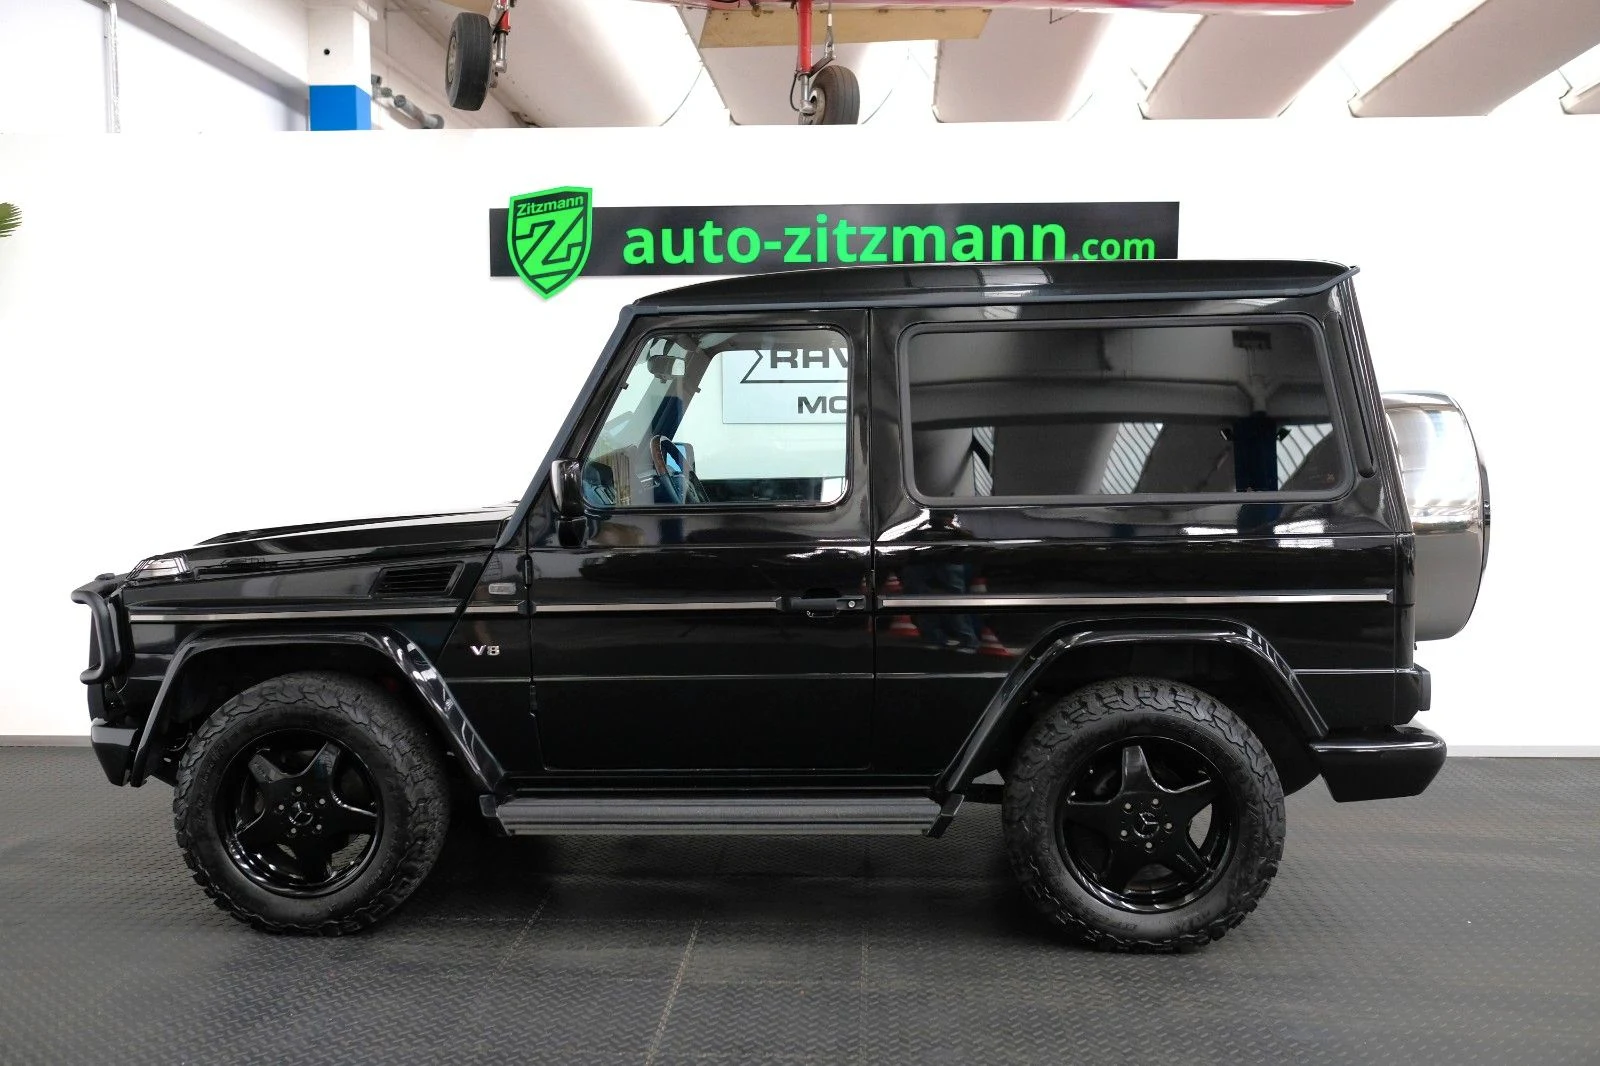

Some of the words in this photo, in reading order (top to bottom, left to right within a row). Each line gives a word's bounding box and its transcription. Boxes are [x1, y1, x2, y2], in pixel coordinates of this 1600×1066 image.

[516, 195, 585, 217] Zitzmann
[622, 213, 1156, 265] auto-zitzmann.com
[469, 644, 500, 656] V8
